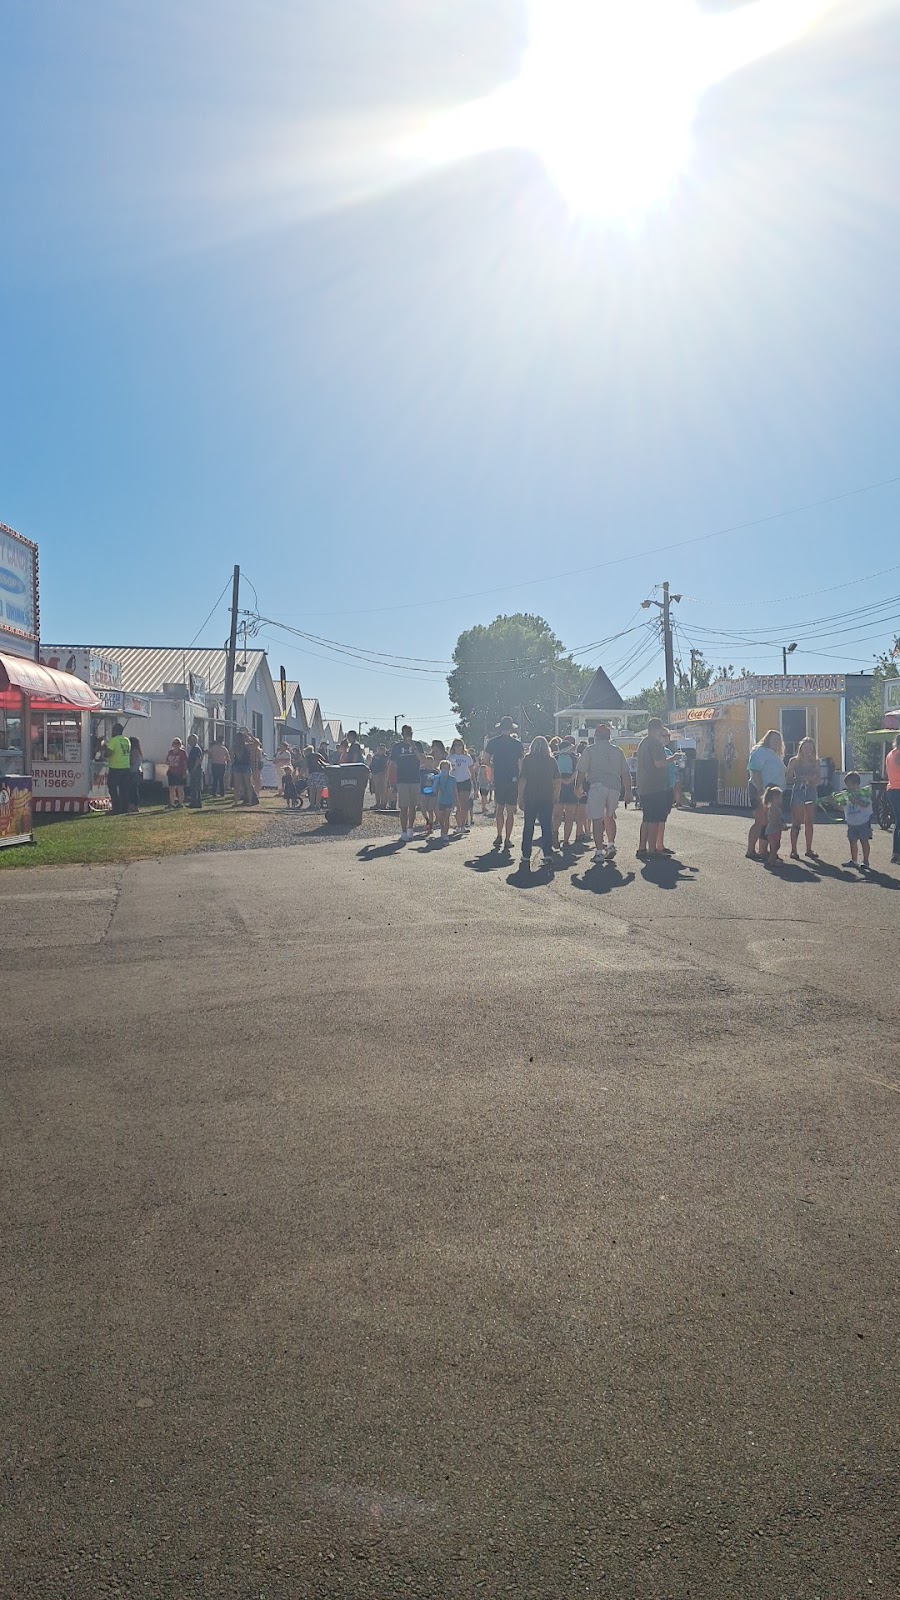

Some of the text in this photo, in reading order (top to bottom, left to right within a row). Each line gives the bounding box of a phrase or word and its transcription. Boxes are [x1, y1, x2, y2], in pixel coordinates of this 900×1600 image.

[99, 659, 113, 674] ICE
[94, 672, 118, 688] CREAM
[761, 678, 802, 690] PRETZEL
[804, 678, 837, 689] WAGON
[44, 779, 68, 788] 1966
